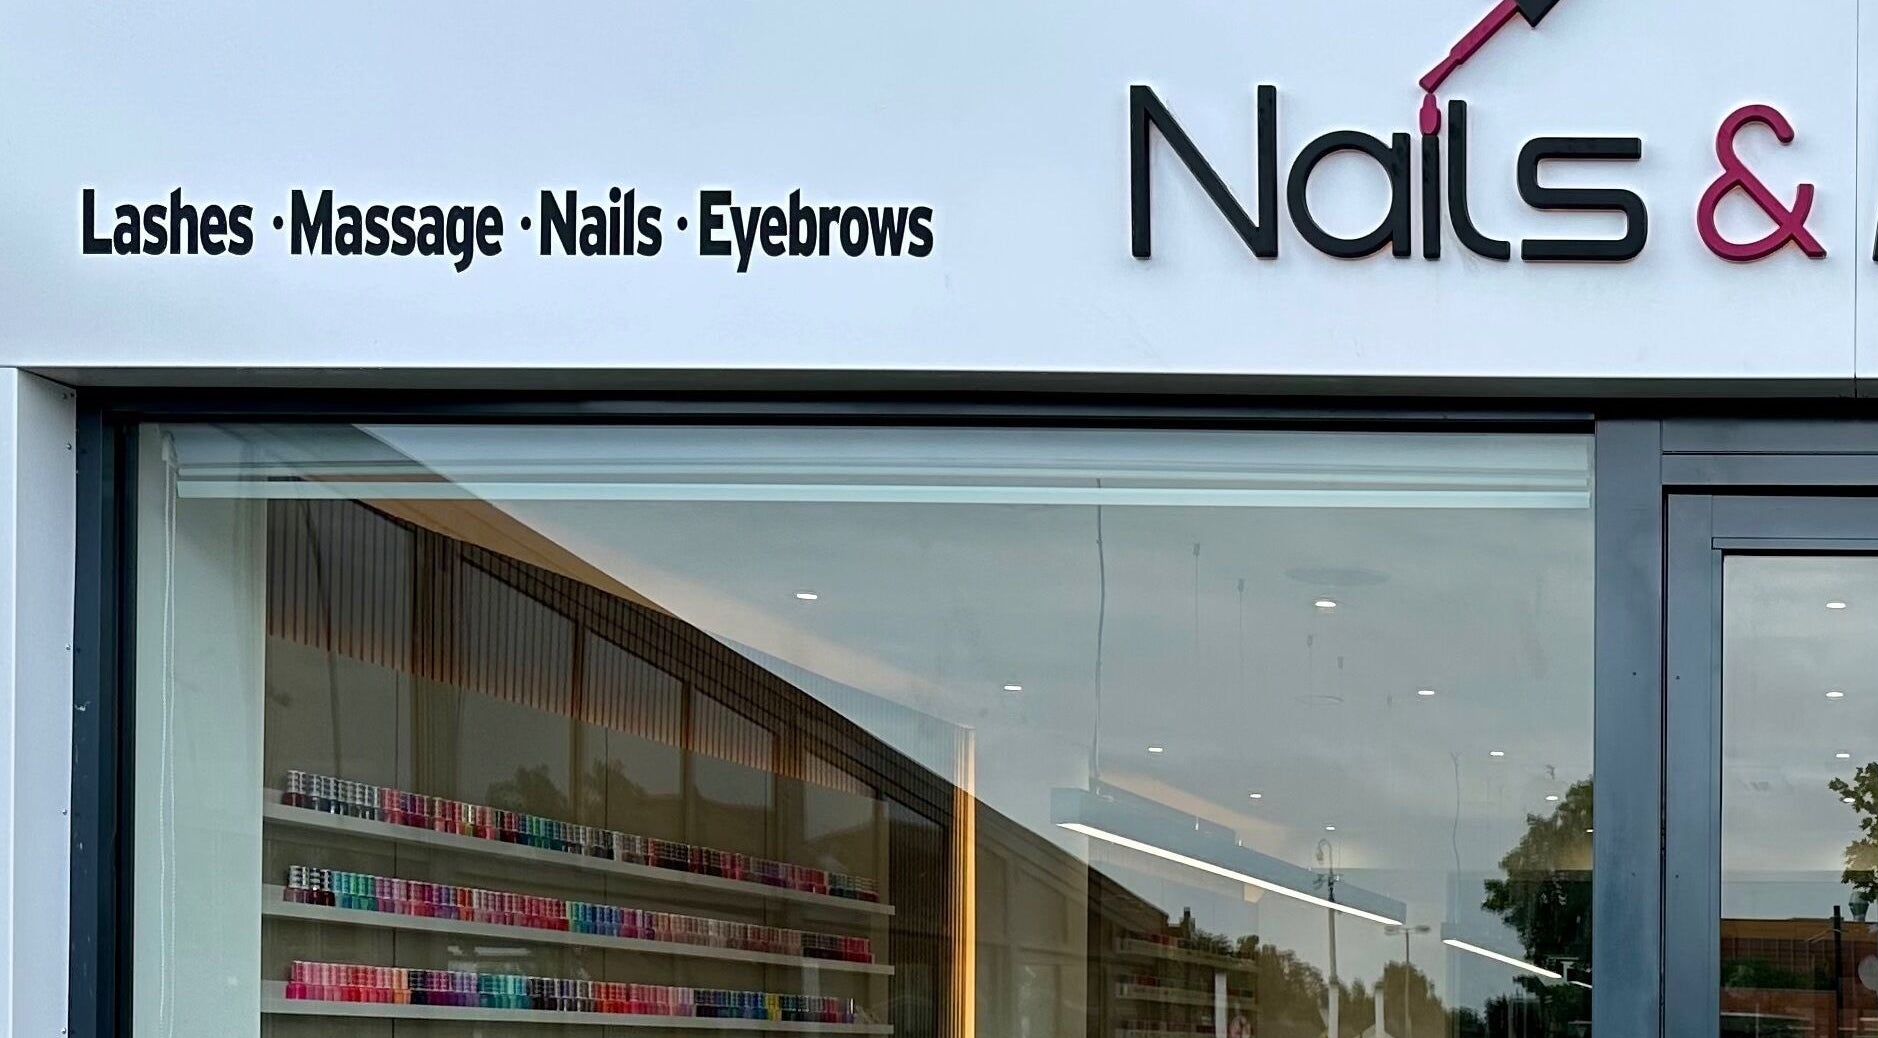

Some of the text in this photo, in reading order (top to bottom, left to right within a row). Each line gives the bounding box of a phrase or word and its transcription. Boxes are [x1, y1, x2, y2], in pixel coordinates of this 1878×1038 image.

[83, 187, 253, 256] Lashes
[1129, 82, 1648, 263] Nails
[1697, 103, 1827, 263] &
